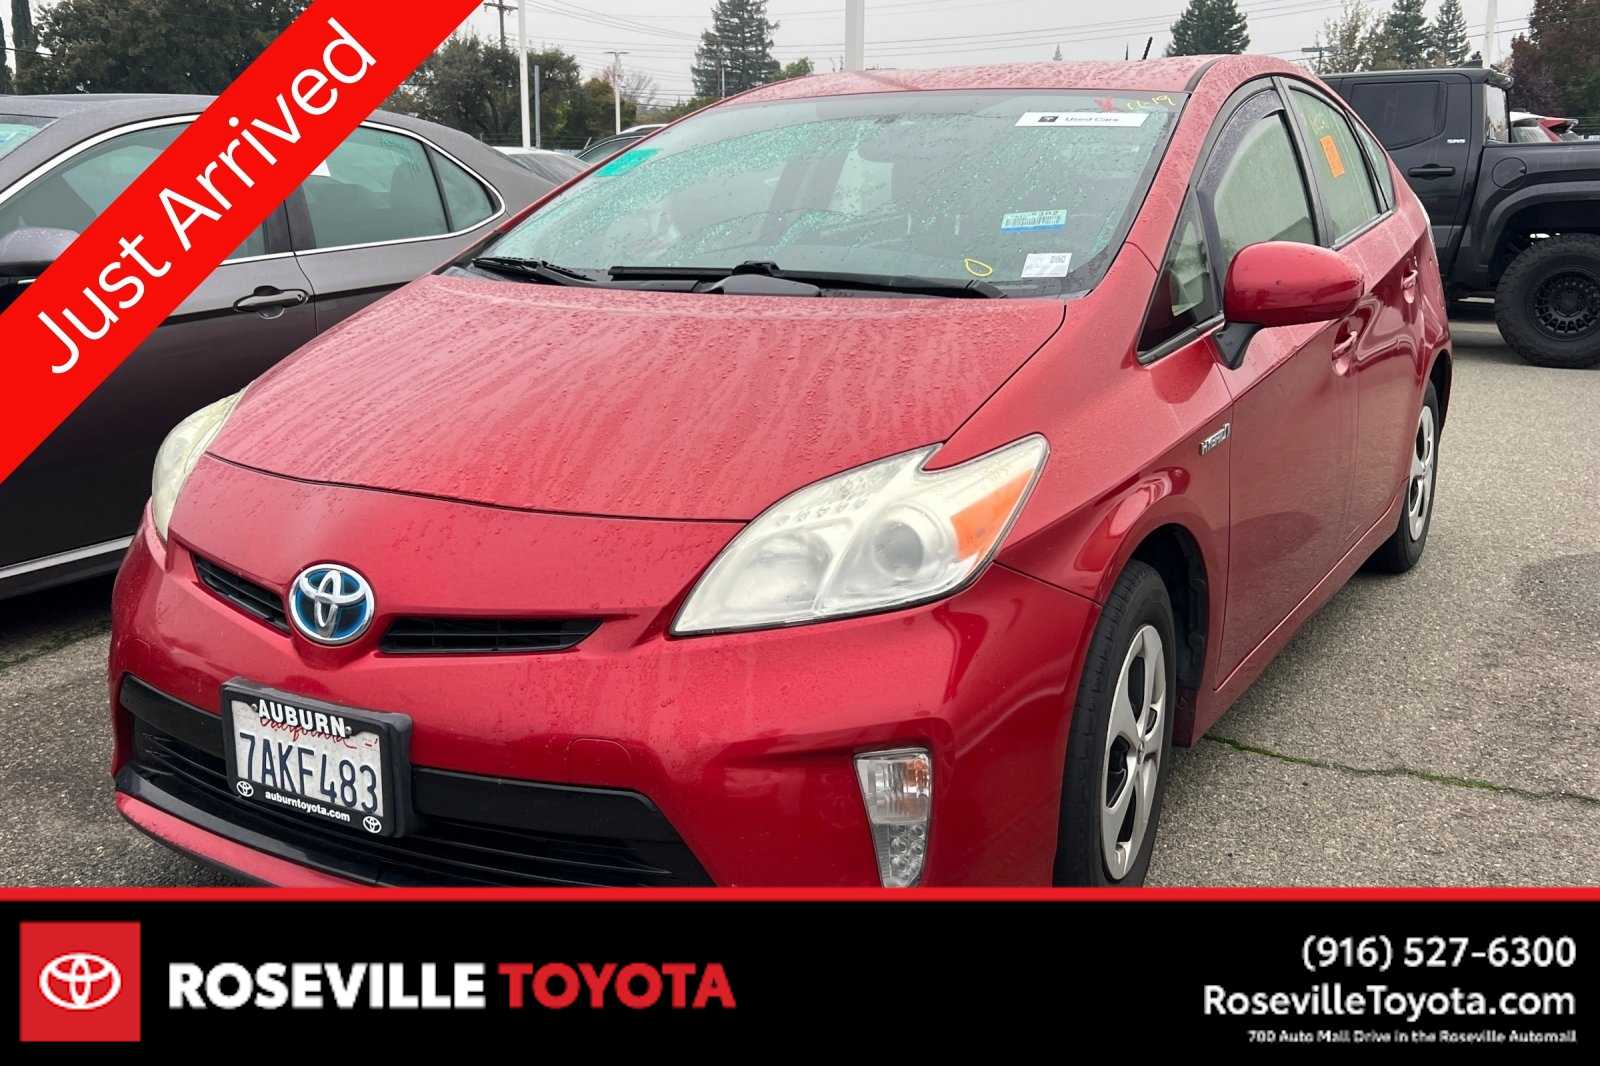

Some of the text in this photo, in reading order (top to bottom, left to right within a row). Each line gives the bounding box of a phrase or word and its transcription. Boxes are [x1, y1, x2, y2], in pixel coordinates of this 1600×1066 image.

[258, 699, 346, 738] AUBURN
[239, 732, 379, 814] 7AKF483
[265, 790, 351, 822] auburntoyota.com
